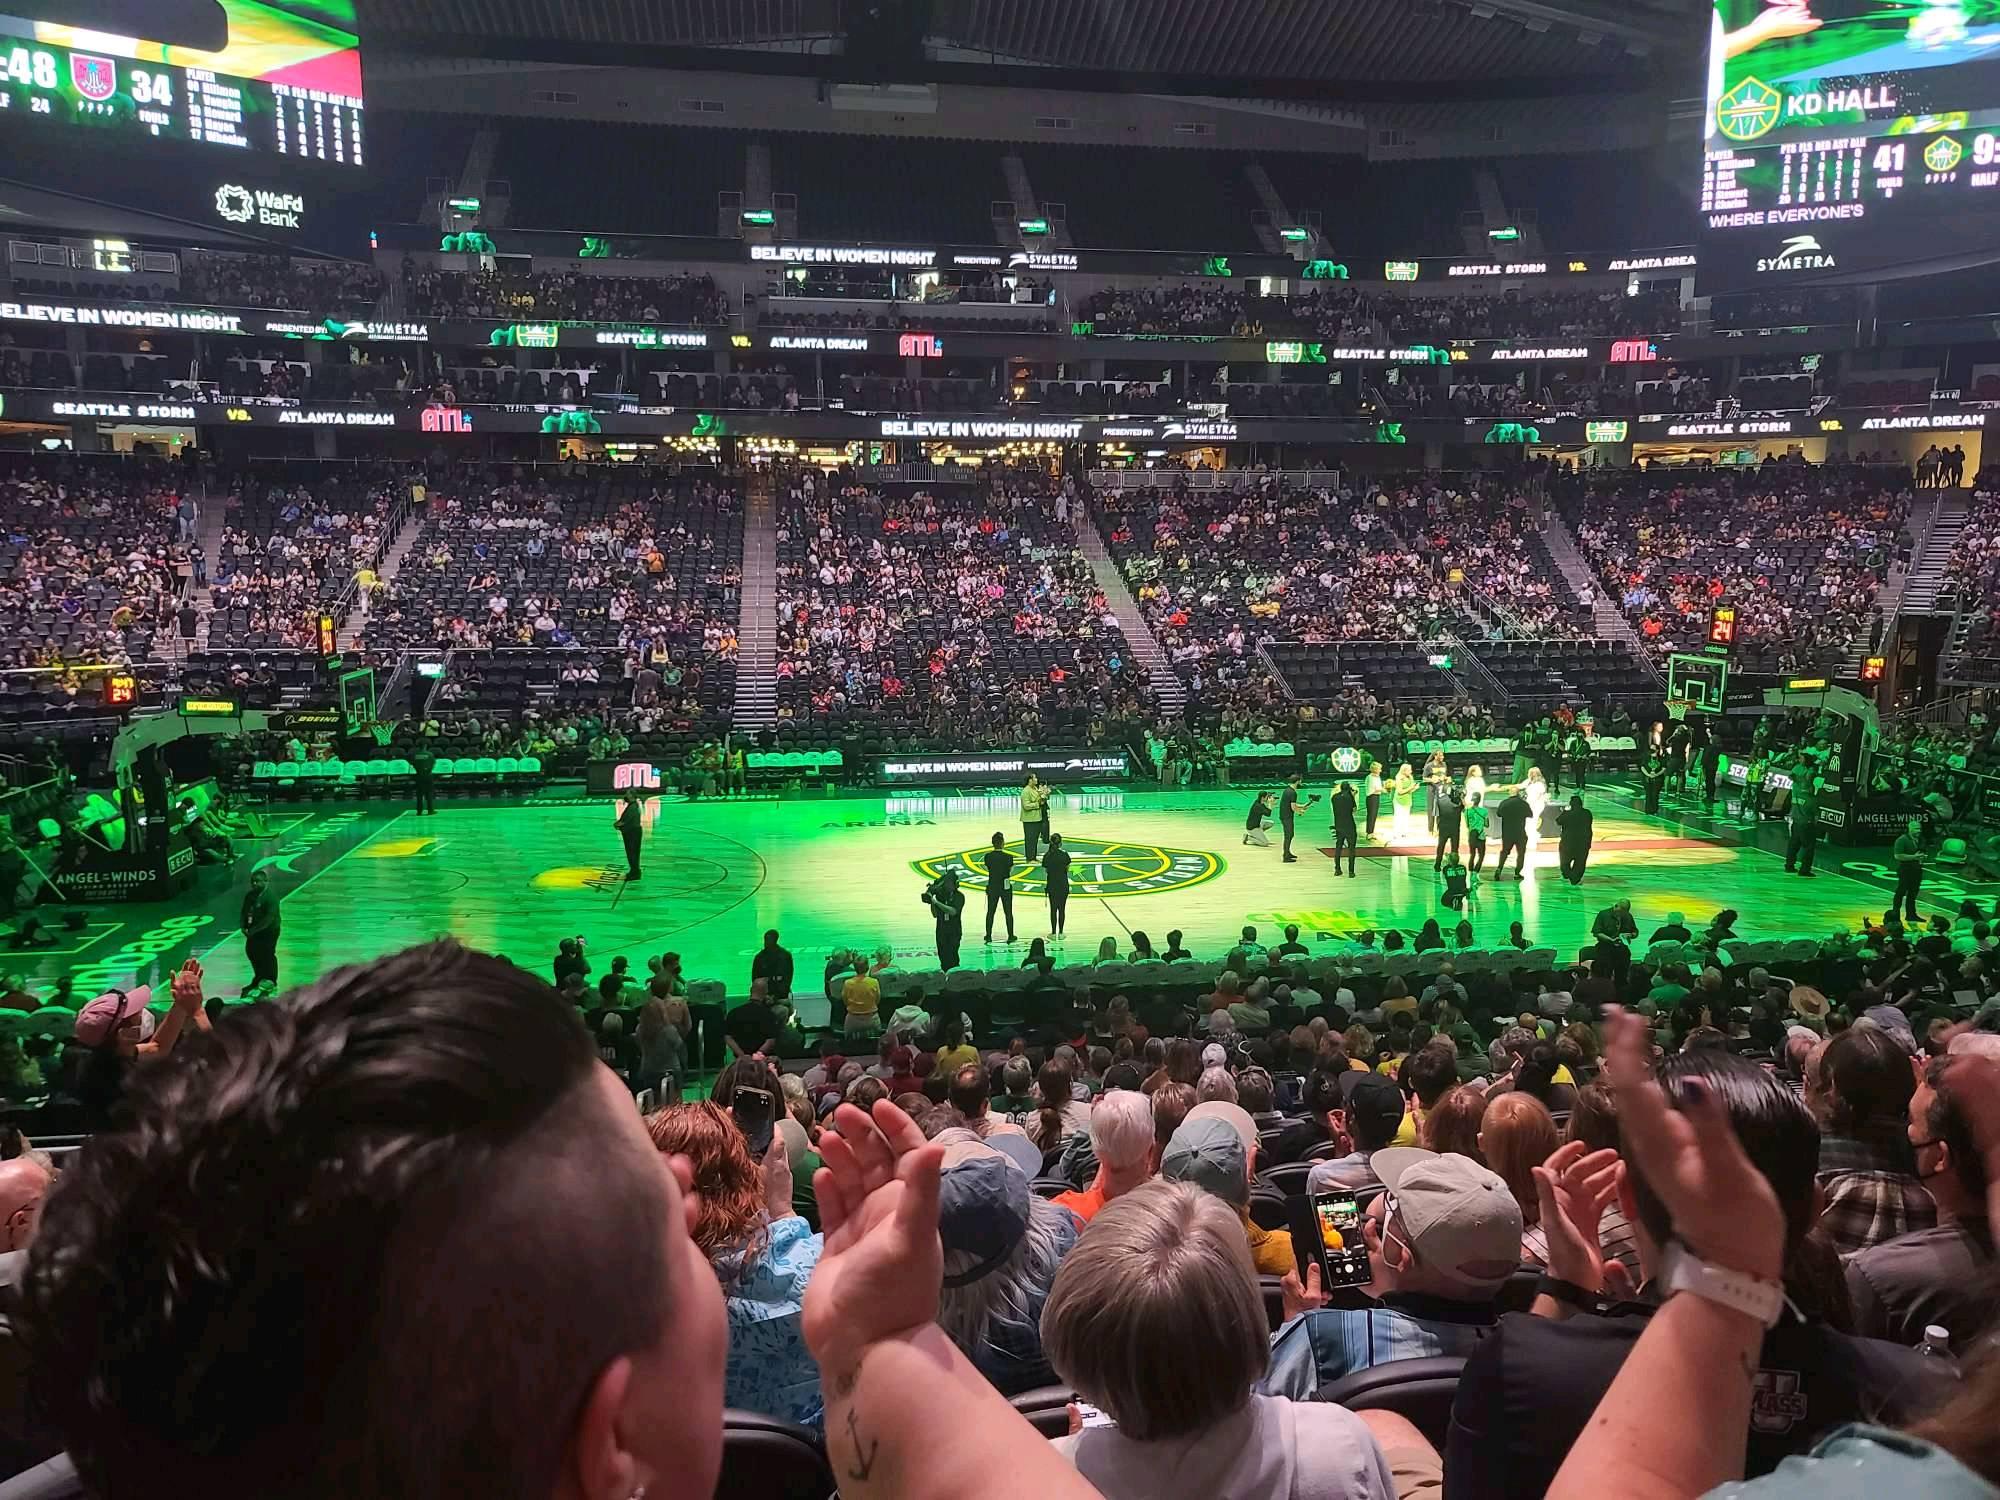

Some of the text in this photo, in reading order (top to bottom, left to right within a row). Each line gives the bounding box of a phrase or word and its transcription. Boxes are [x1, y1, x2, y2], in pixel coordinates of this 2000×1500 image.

[131, 70, 173, 106] 34
[31, 97, 50, 113] 24
[1787, 87, 1896, 116] KD HALL
[1833, 139, 1849, 149] AST
[1873, 144, 1905, 172] 41
[1972, 172, 1999, 186] HALF
[256, 190, 303, 211] WaFd
[259, 210, 299, 228] Bank
[1709, 204, 1864, 228] WHERE EVERYONE'S
[751, 247, 936, 265] BELIEVE IN WOMEN NIGHT
[954, 256, 990, 264] PRESENTED
[1029, 254, 1077, 264] SYMETRA
[1757, 255, 1836, 271] SYMETRA
[1449, 255, 1697, 275] SEATTLE STORM VS. ATLANTA DREA
[0, 303, 241, 331] ELIEVE IN WOMEN NIGHT
[266, 322, 314, 333] PRESENTED
[368, 322, 427, 335] SYMETRA
[597, 333, 867, 350] SEATTLE STORM VS. ATLANTA DREAM
[900, 334, 942, 356] ATL
[1334, 348, 1588, 360] SEATTLE STORM VS. ATLANTA DREAM
[1611, 341, 1657, 362] ATL
[53, 403, 395, 425] SEATTLE STORM VS. ATLANTA DREAM
[421, 410, 472, 432] ATL
[882, 421, 1083, 438] BELIEVE IN WOMEN NIGHT
[1103, 428, 1141, 436] PRESENTED
[1184, 424, 1238, 435] SYMETRA
[1668, 415, 1985, 435] SEATTLE STORM VS. ATLANTA DREAM
[1713, 621, 1732, 641] 24
[1865, 667, 1881, 678] 24
[112, 688, 132, 701] 24
[298, 715, 340, 723] BOEING
[884, 761, 1024, 773] BELIEVE IN WOMEN NIGHT
[1082, 758, 1124, 766] SYMETRA
[614, 763, 660, 789] ATL
[819, 819, 937, 828] ARENA
[1820, 810, 1842, 823] ECU
[1857, 813, 1889, 823] ANGEL
[56, 869, 157, 884] ANGEL WINDS
[1125, 855, 1203, 890] STORM
